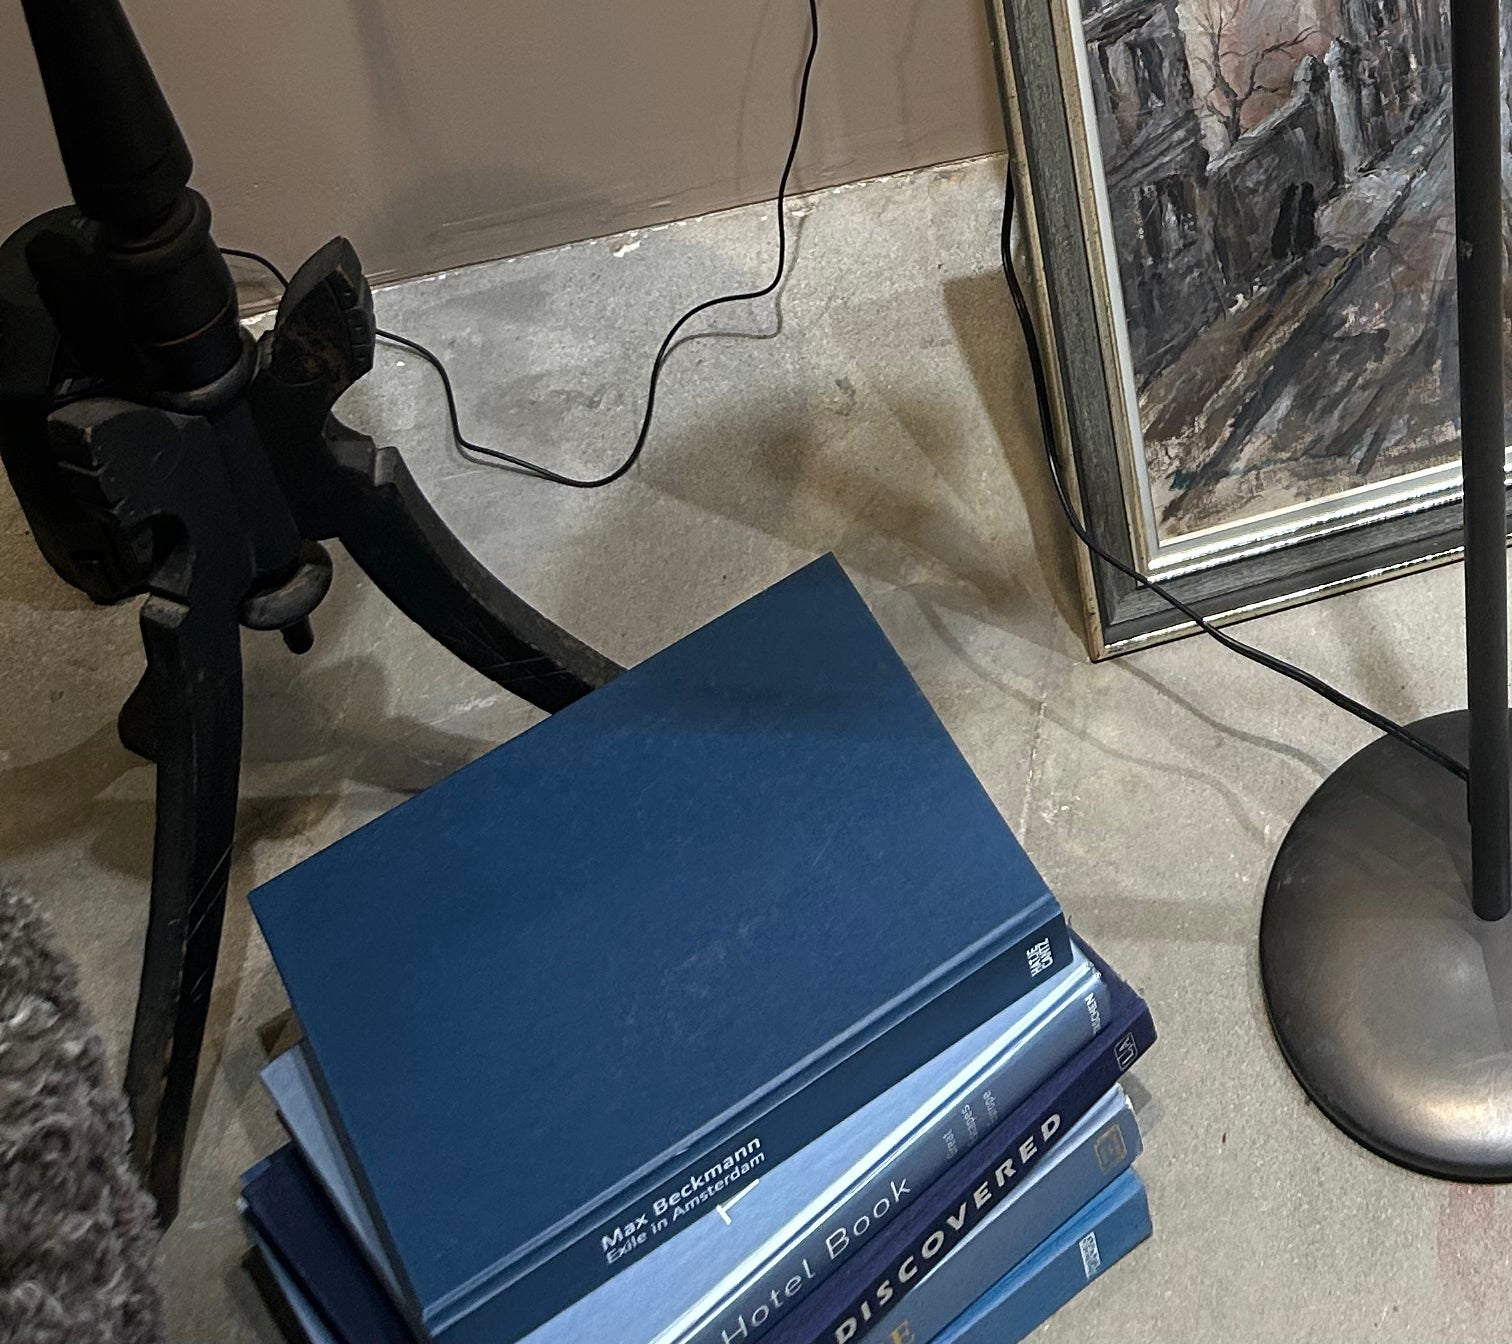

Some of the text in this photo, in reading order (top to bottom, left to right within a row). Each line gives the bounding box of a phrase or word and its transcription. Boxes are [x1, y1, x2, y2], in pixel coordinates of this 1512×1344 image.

[1026, 943, 1043, 978] HATJE
[1037, 937, 1054, 969] CANTZ
[600, 1136, 762, 1252] Max Beckmann
[605, 1151, 766, 1265] Exile in Amsterdam
[834, 1112, 1062, 1344] DISCOVERED
[720, 1175, 912, 1344] Hotel Book
